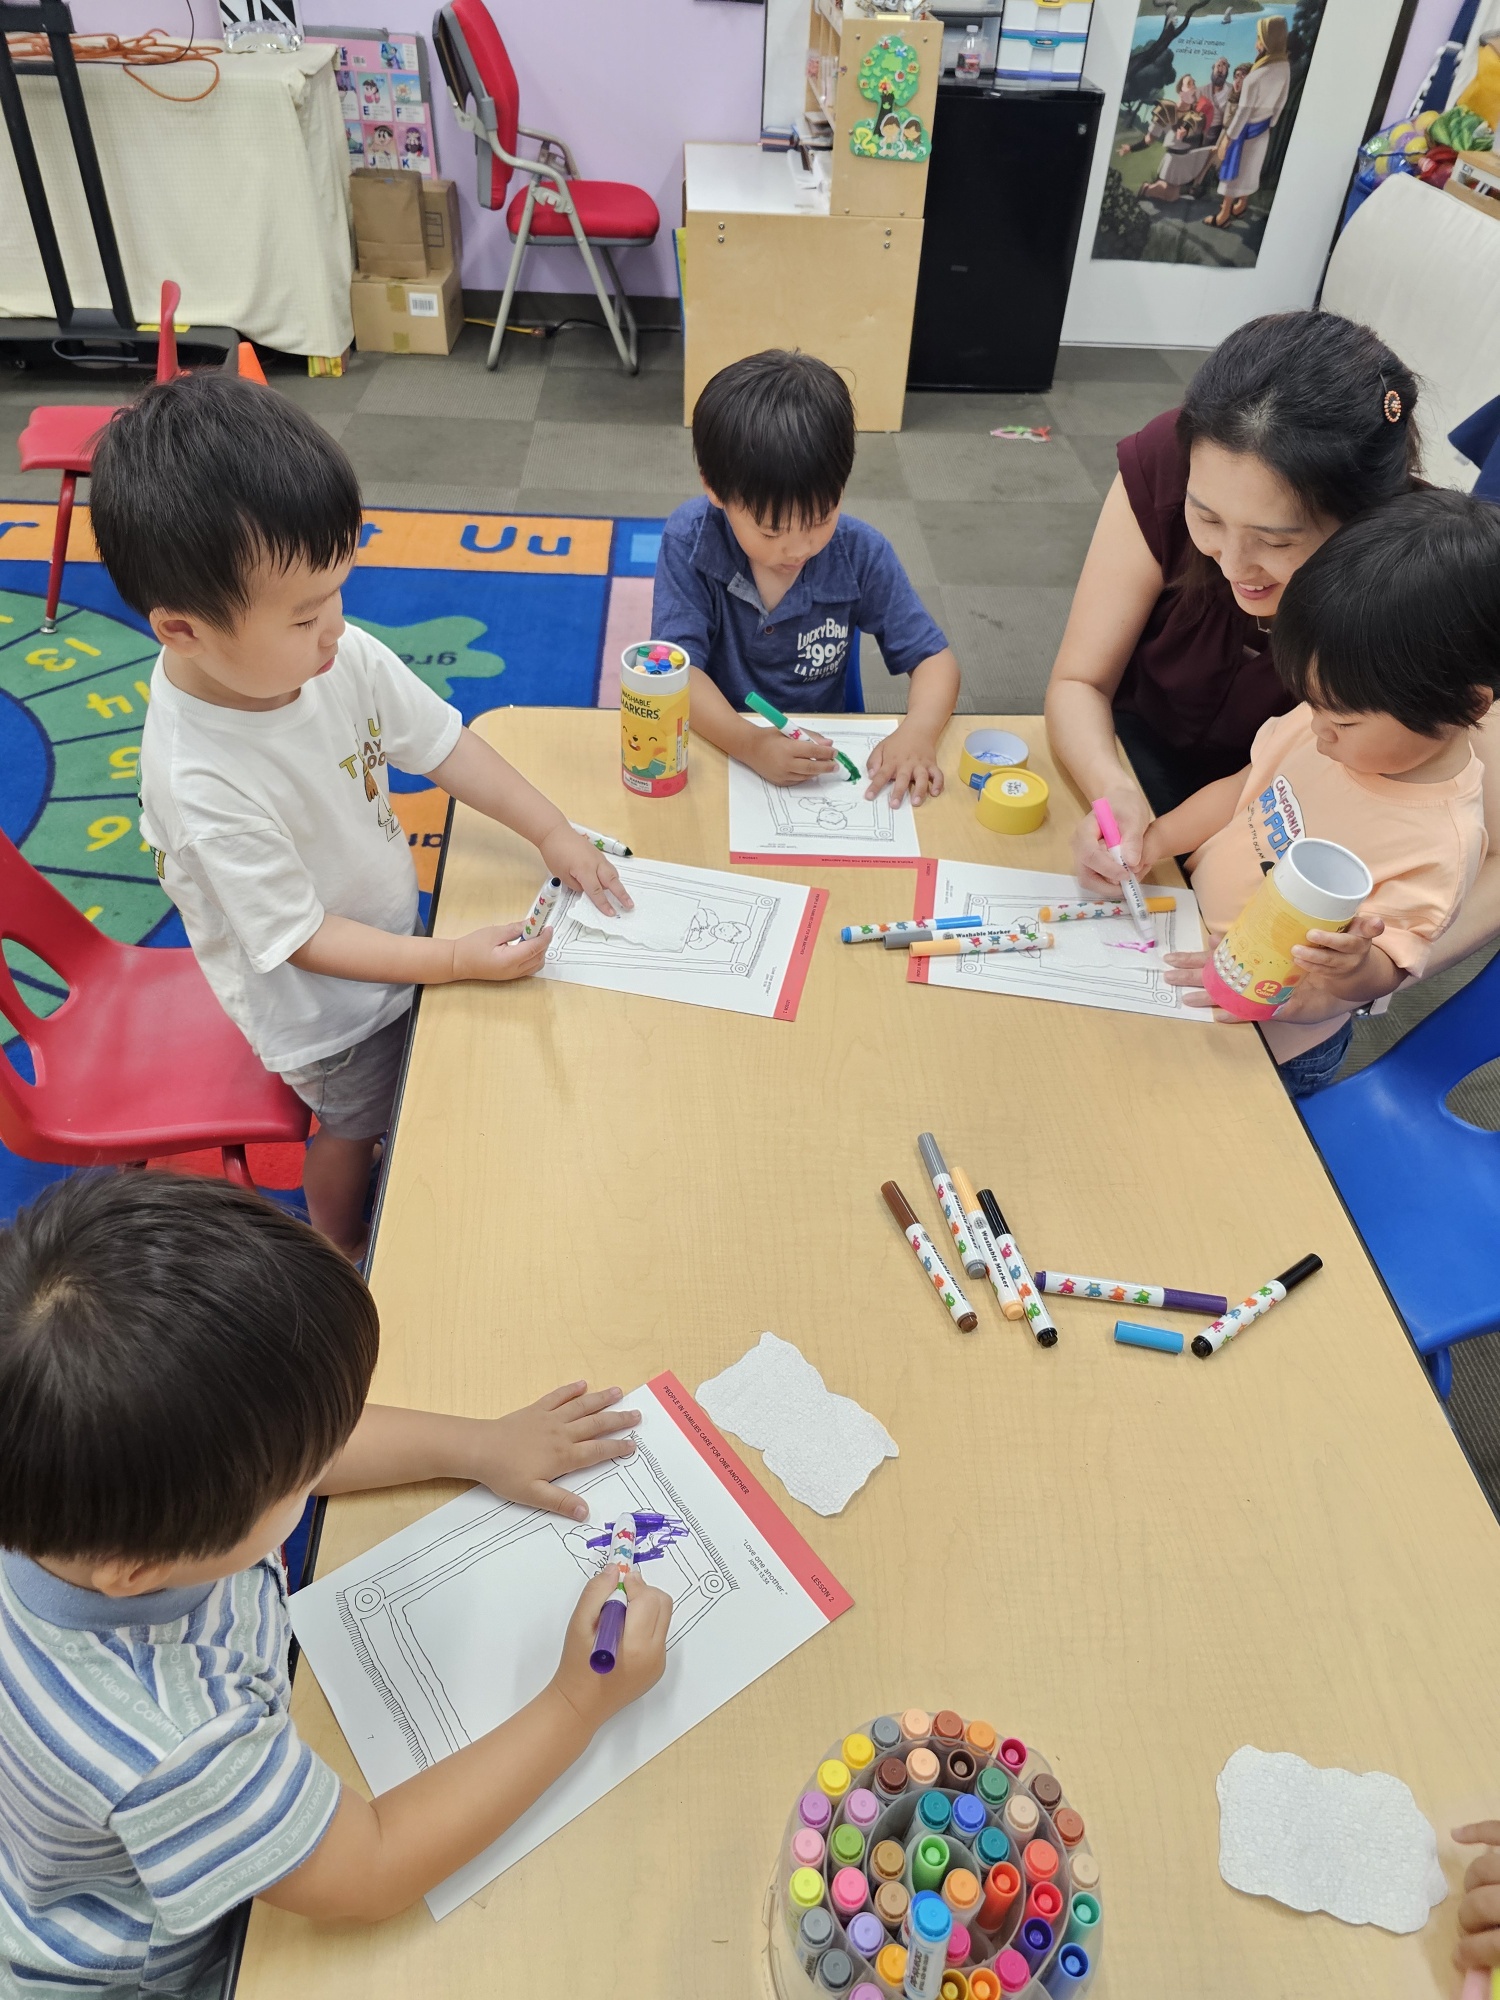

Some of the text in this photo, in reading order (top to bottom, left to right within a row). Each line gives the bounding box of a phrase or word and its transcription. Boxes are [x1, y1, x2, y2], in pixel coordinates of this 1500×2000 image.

[402, 158, 410, 168] K
[797, 624, 826, 650] LUCKY
[26, 638, 102, 672] 13
[622, 691, 652, 708] WASHABLE
[338, 754, 358, 780] T
[1262, 982, 1278, 993] 12
[981, 1230, 1010, 1288] Washable Marker
[663, 1386, 750, 1494] PEOPLE IN FAMILIES CARE FOR ONE ANOTHER
[744, 1539, 788, 1596] "Love one another."
[748, 1559, 770, 1585] John 13:34
[811, 1574, 831, 1598] LESSON
[100, 1671, 131, 1704] Klein
[144, 1806, 182, 1831] Klein
[186, 1771, 232, 1809] Calvin
